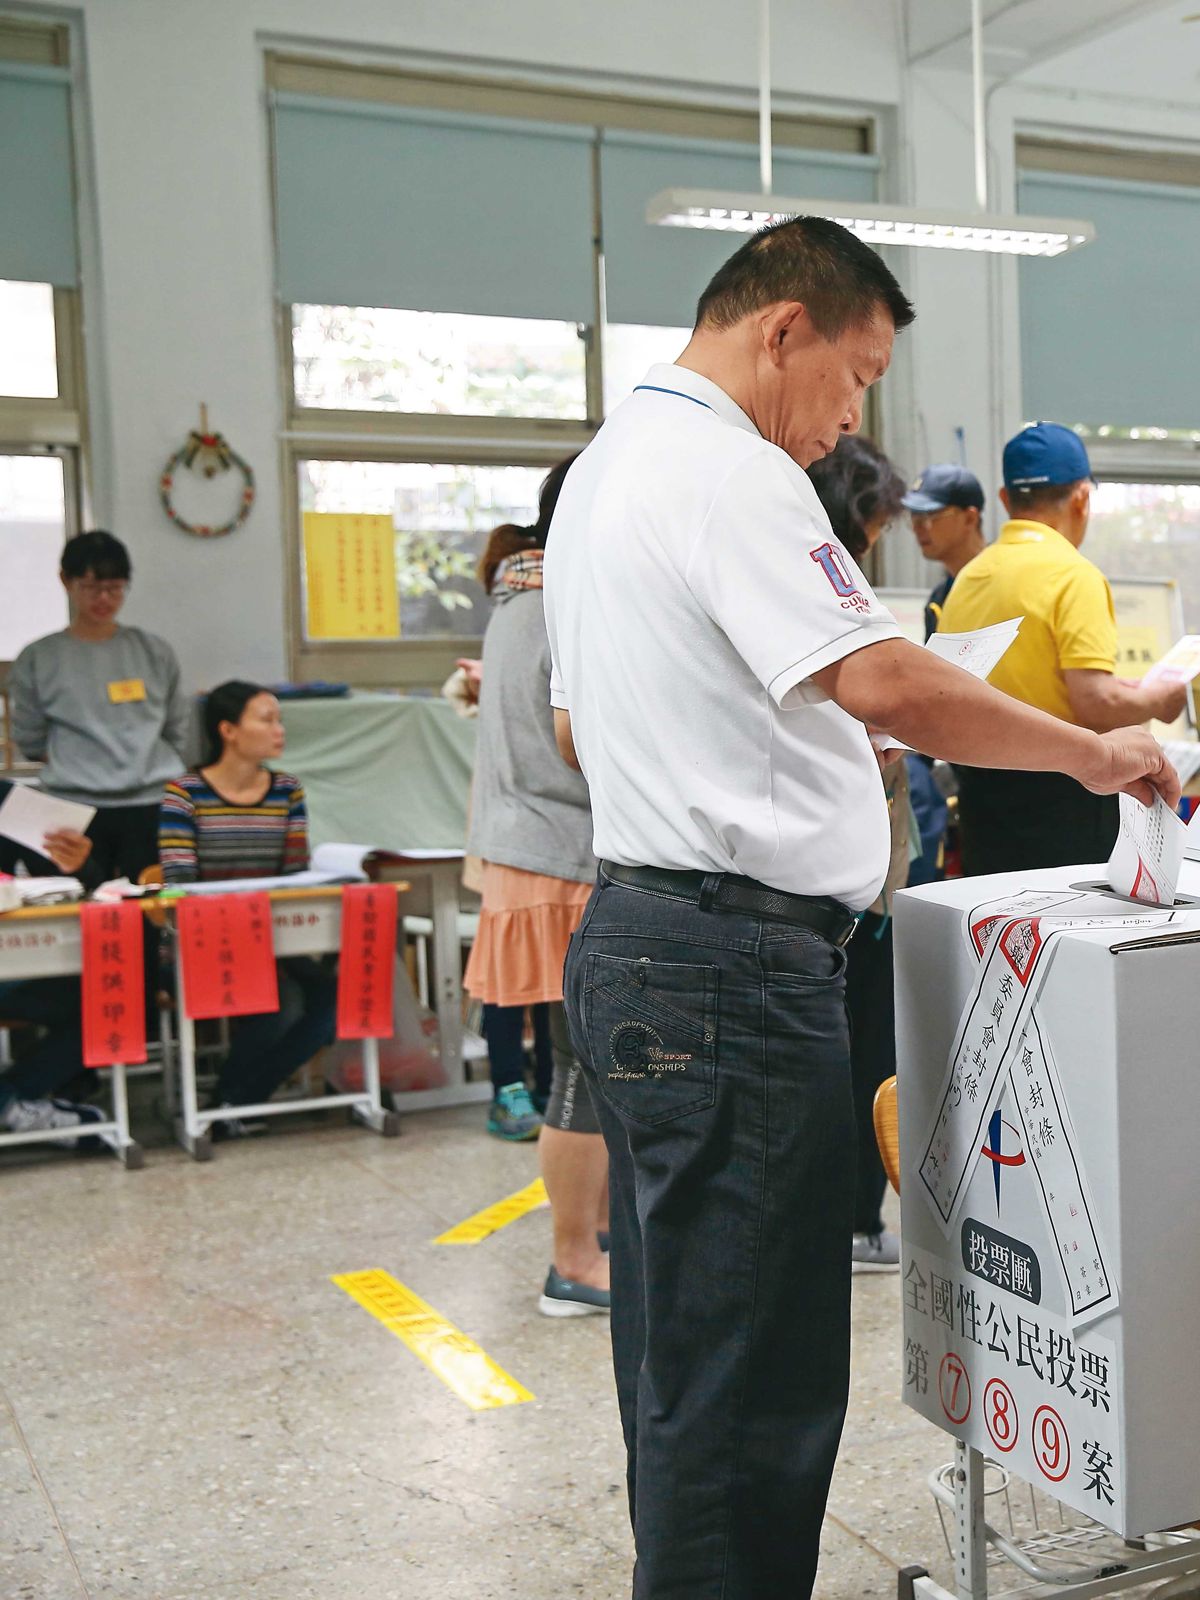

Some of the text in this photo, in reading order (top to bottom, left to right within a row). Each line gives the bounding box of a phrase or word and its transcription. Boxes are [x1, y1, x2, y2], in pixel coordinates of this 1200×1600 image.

[969, 1229, 1033, 1300] 投票匭
[903, 1258, 1112, 1414] 全國性公民投票
